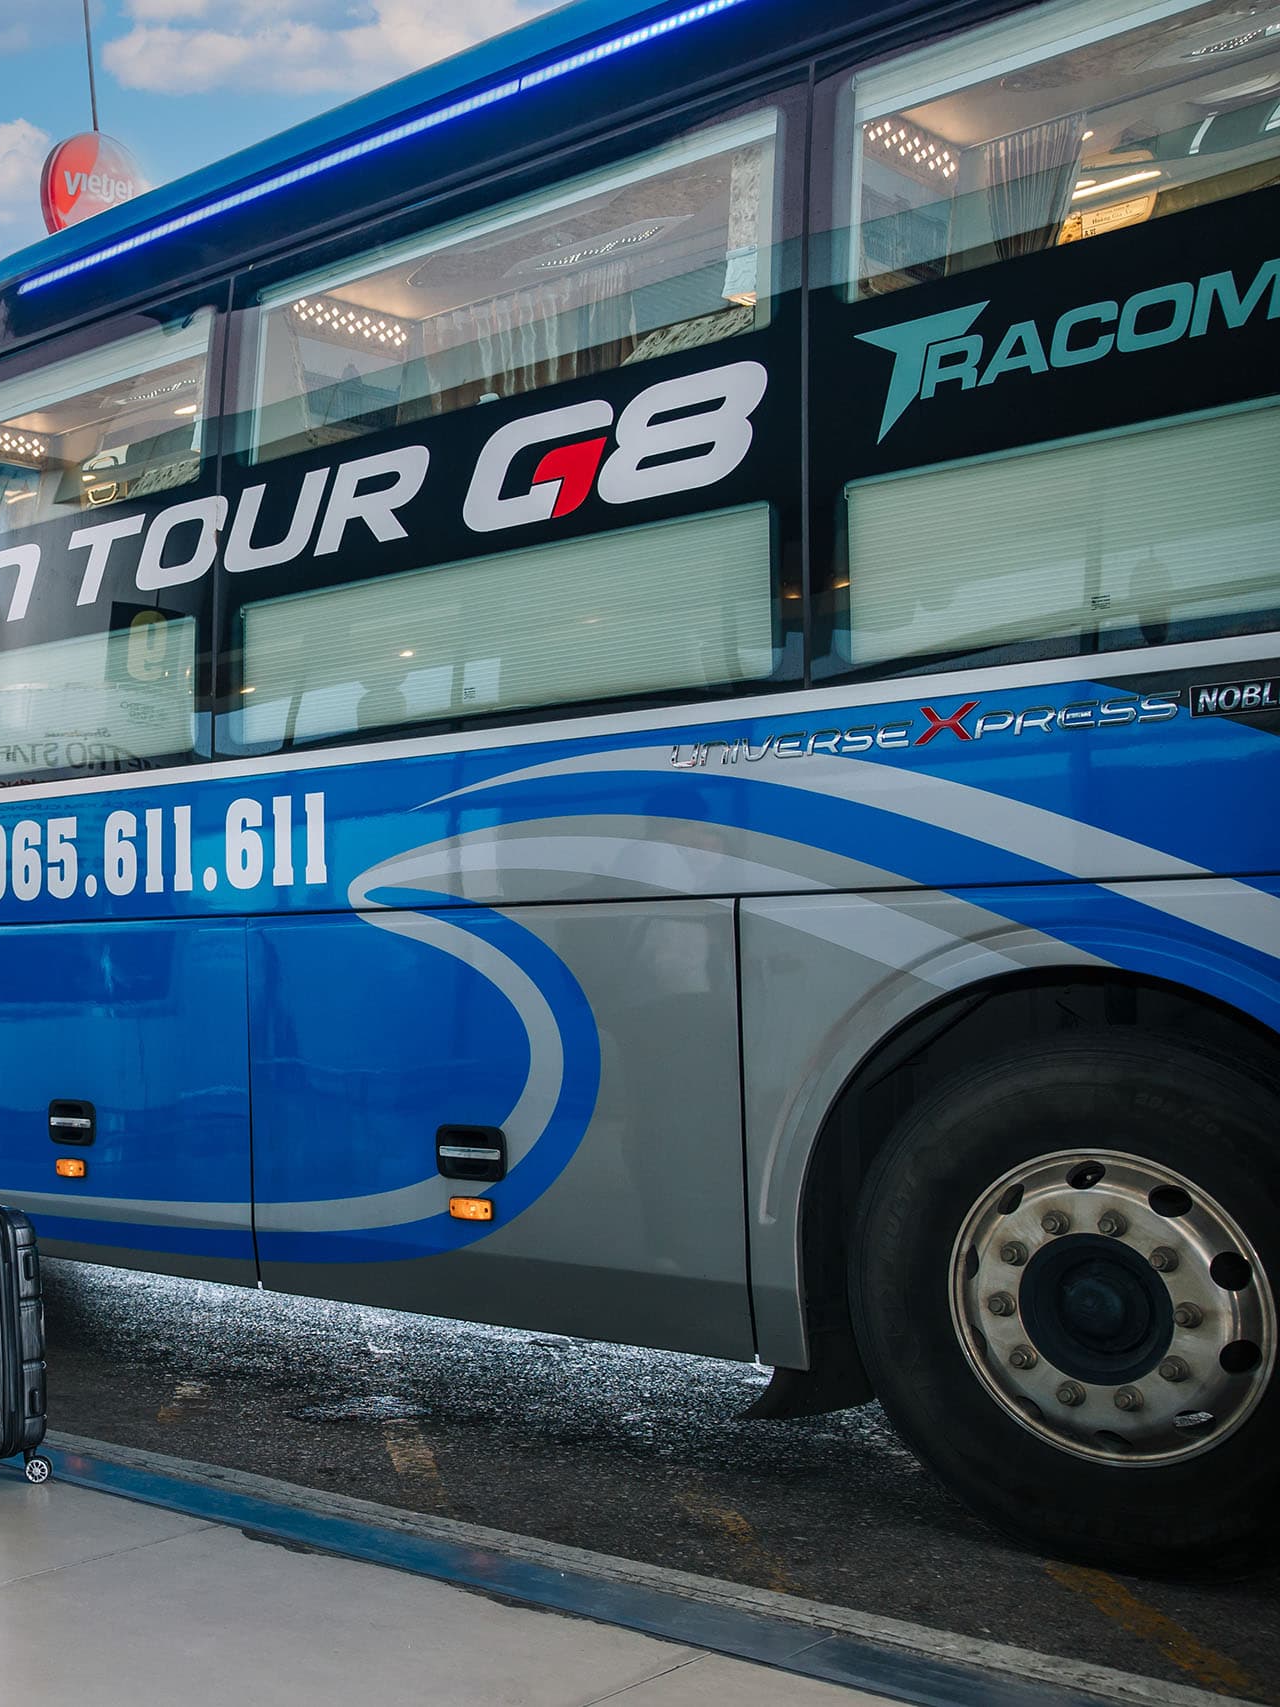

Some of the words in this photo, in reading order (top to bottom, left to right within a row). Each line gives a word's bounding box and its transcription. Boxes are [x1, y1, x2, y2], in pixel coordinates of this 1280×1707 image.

[68, 445, 430, 606] TOUR
[462, 360, 768, 533] G8
[1196, 681, 1280, 714] NOBL
